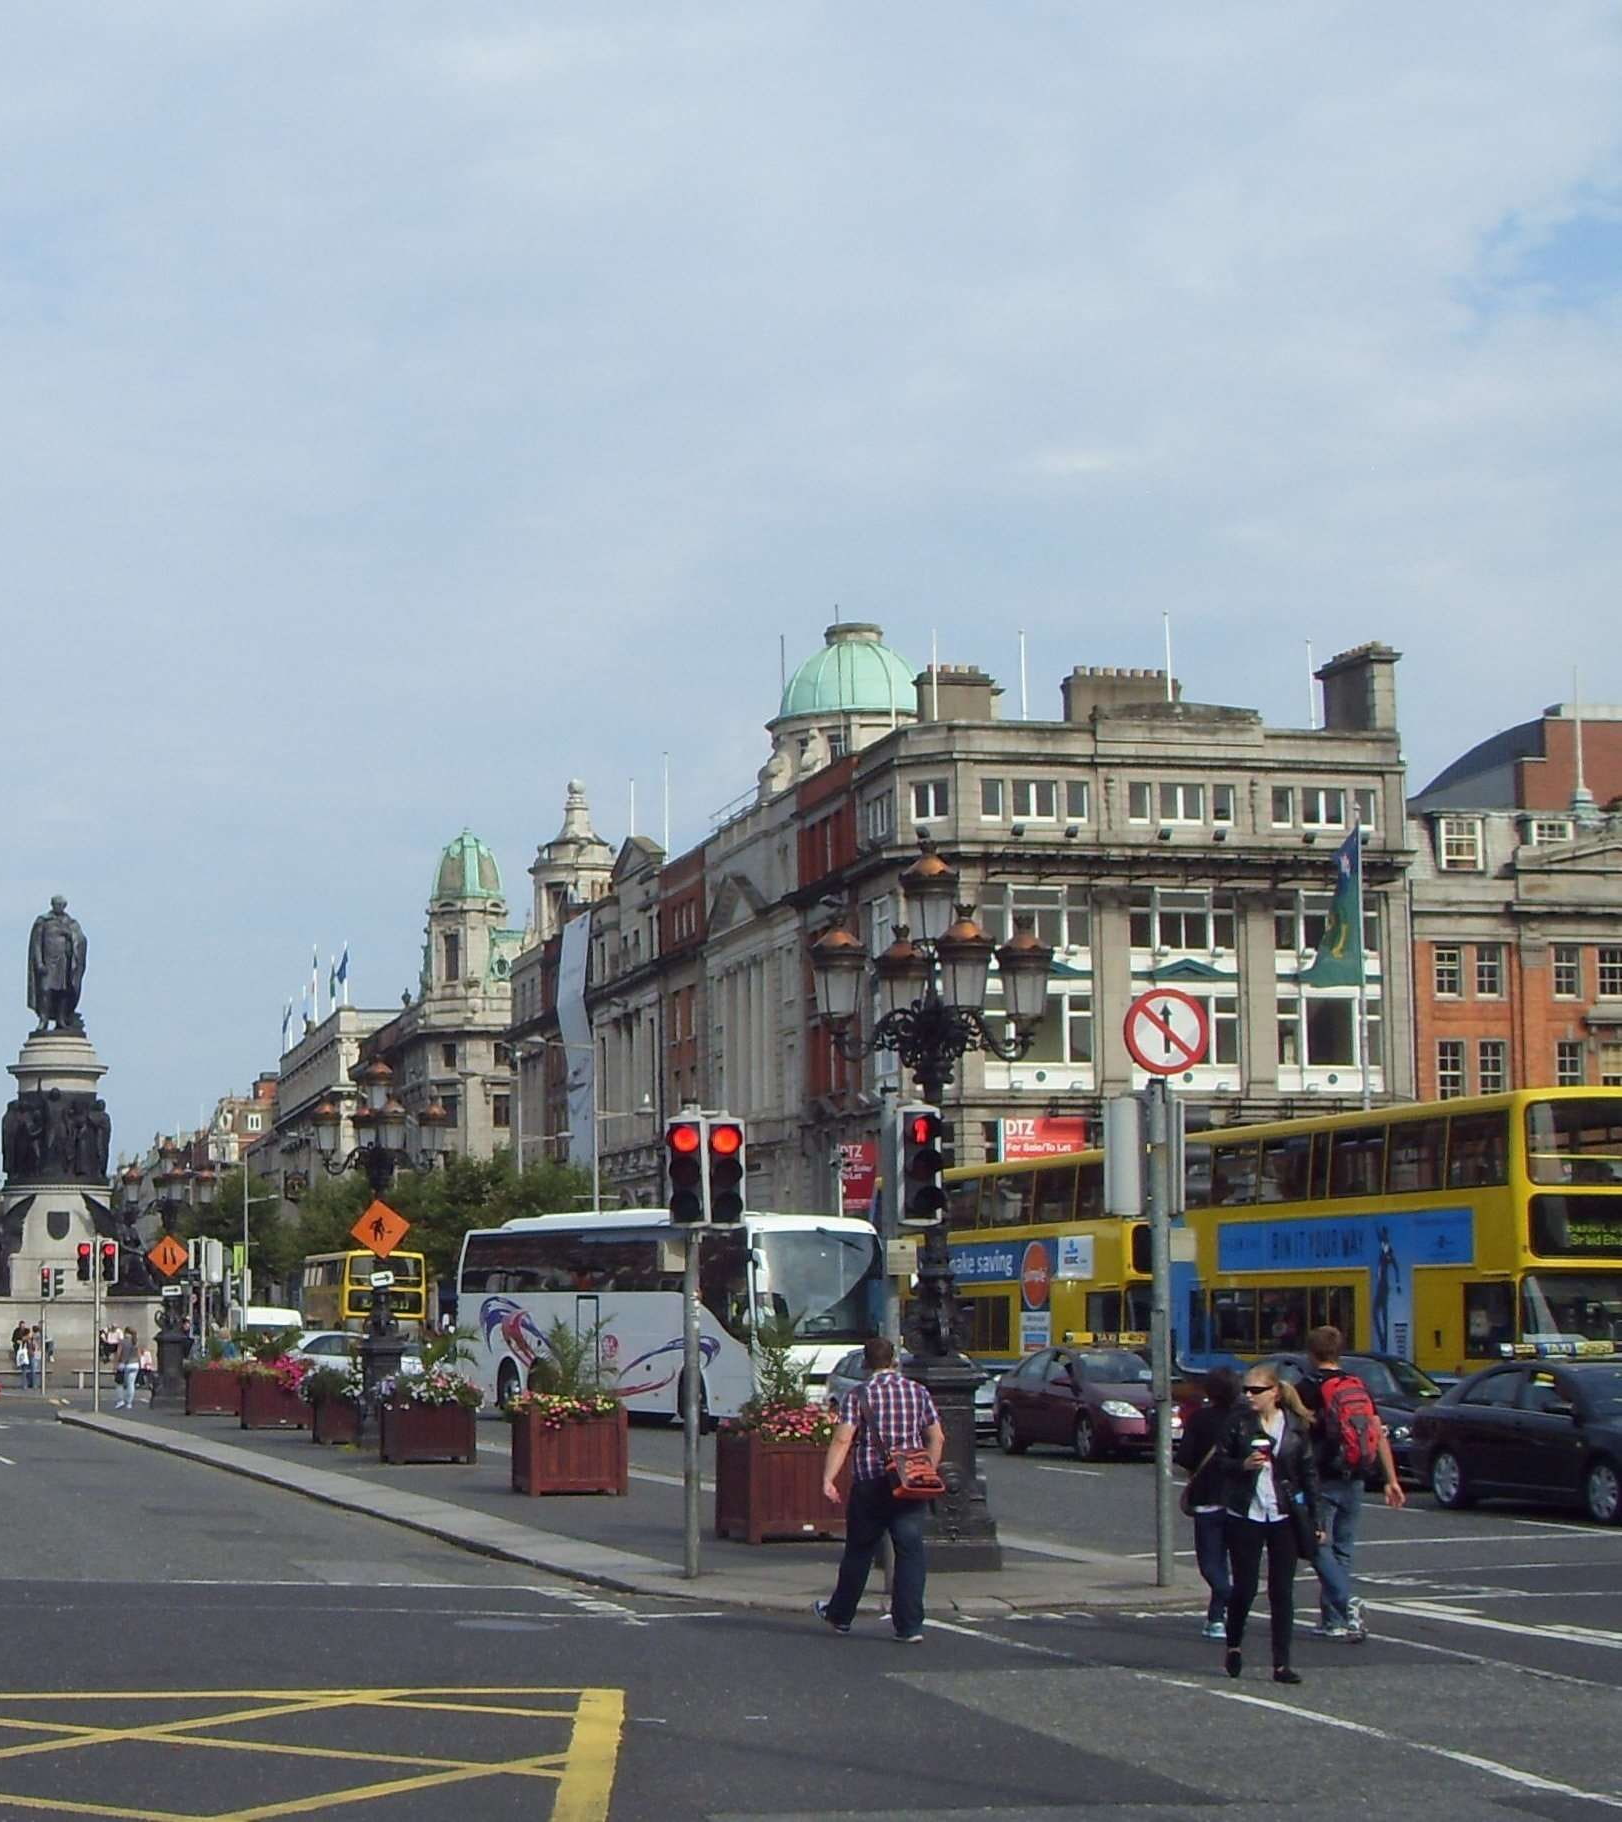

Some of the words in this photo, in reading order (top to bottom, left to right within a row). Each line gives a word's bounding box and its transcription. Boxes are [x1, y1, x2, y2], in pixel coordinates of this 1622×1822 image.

[1006, 1119, 1035, 1135] DTZ
[1006, 1143, 1021, 1153] For
[1057, 1143, 1072, 1152] Let
[977, 1249, 1013, 1277] saving
[1097, 1332, 1117, 1343] TAXI
[1546, 1343, 1572, 1355] TAXI
